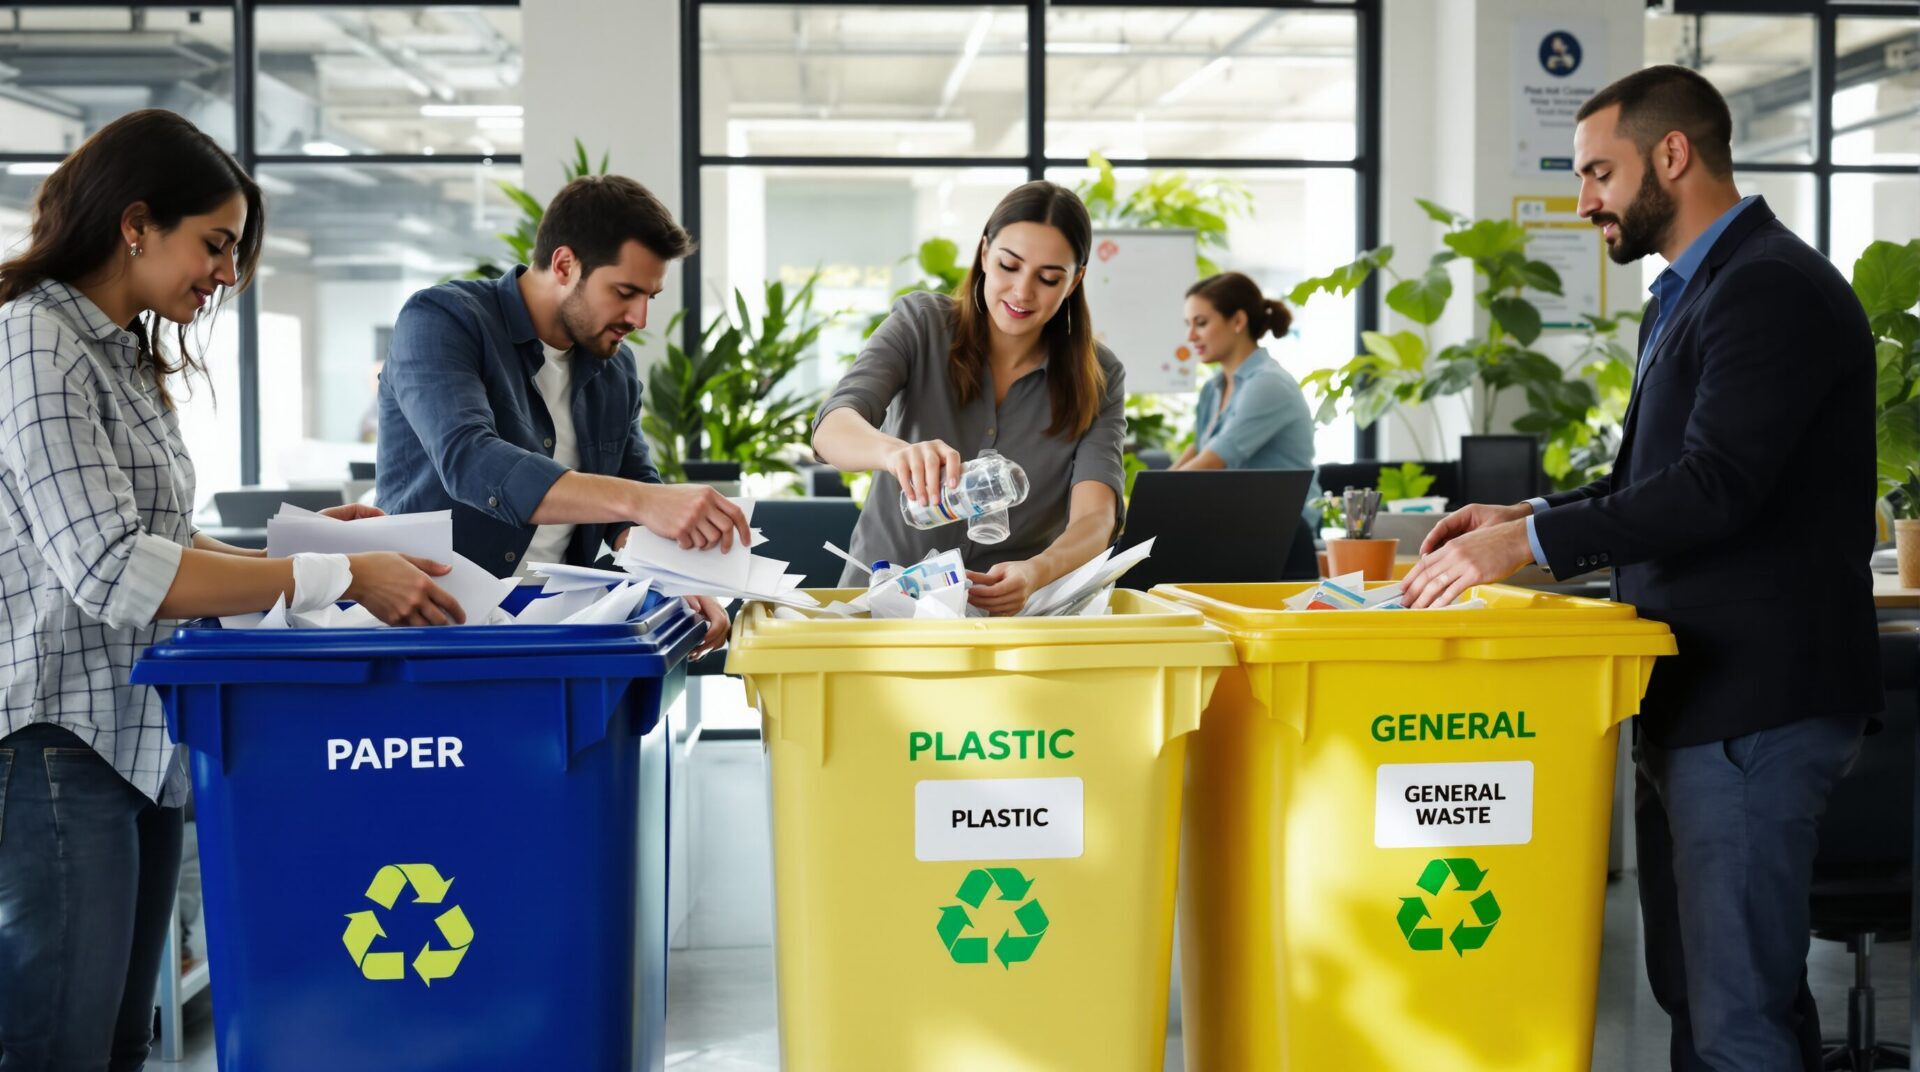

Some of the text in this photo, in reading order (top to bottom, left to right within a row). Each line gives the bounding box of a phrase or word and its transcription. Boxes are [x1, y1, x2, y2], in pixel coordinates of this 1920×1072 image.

[1371, 711, 1536, 742] GENERAL
[327, 735, 465, 770] PAPER
[909, 728, 1075, 762] PLASTIC
[1404, 782, 1507, 803] GENERAL
[951, 807, 1049, 829] PLASTIC
[1415, 806, 1491, 826] WASTE
